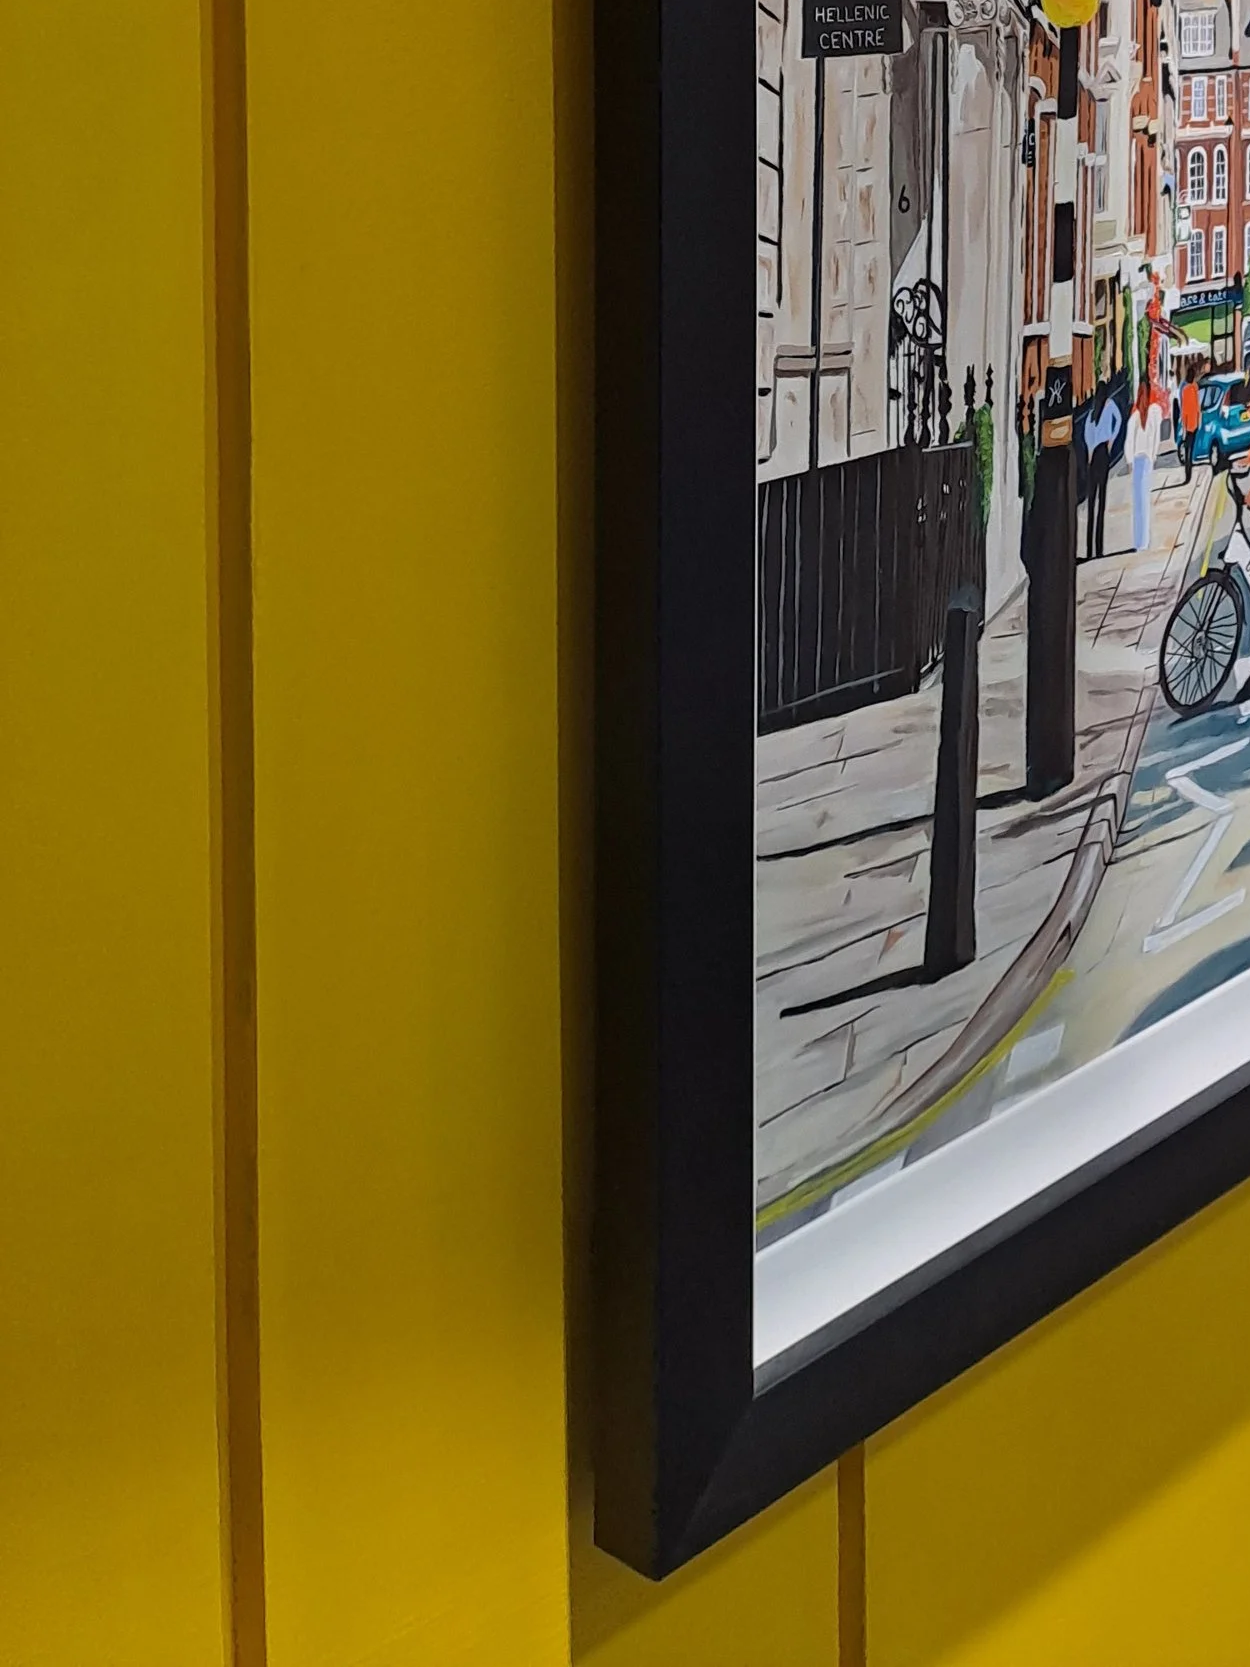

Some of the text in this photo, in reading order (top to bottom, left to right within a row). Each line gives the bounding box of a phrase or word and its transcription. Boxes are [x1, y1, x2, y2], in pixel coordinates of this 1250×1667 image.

[815, 5, 890, 23] HELLENIC
[819, 27, 885, 50] CENTRE
[898, 185, 911, 214] 6
